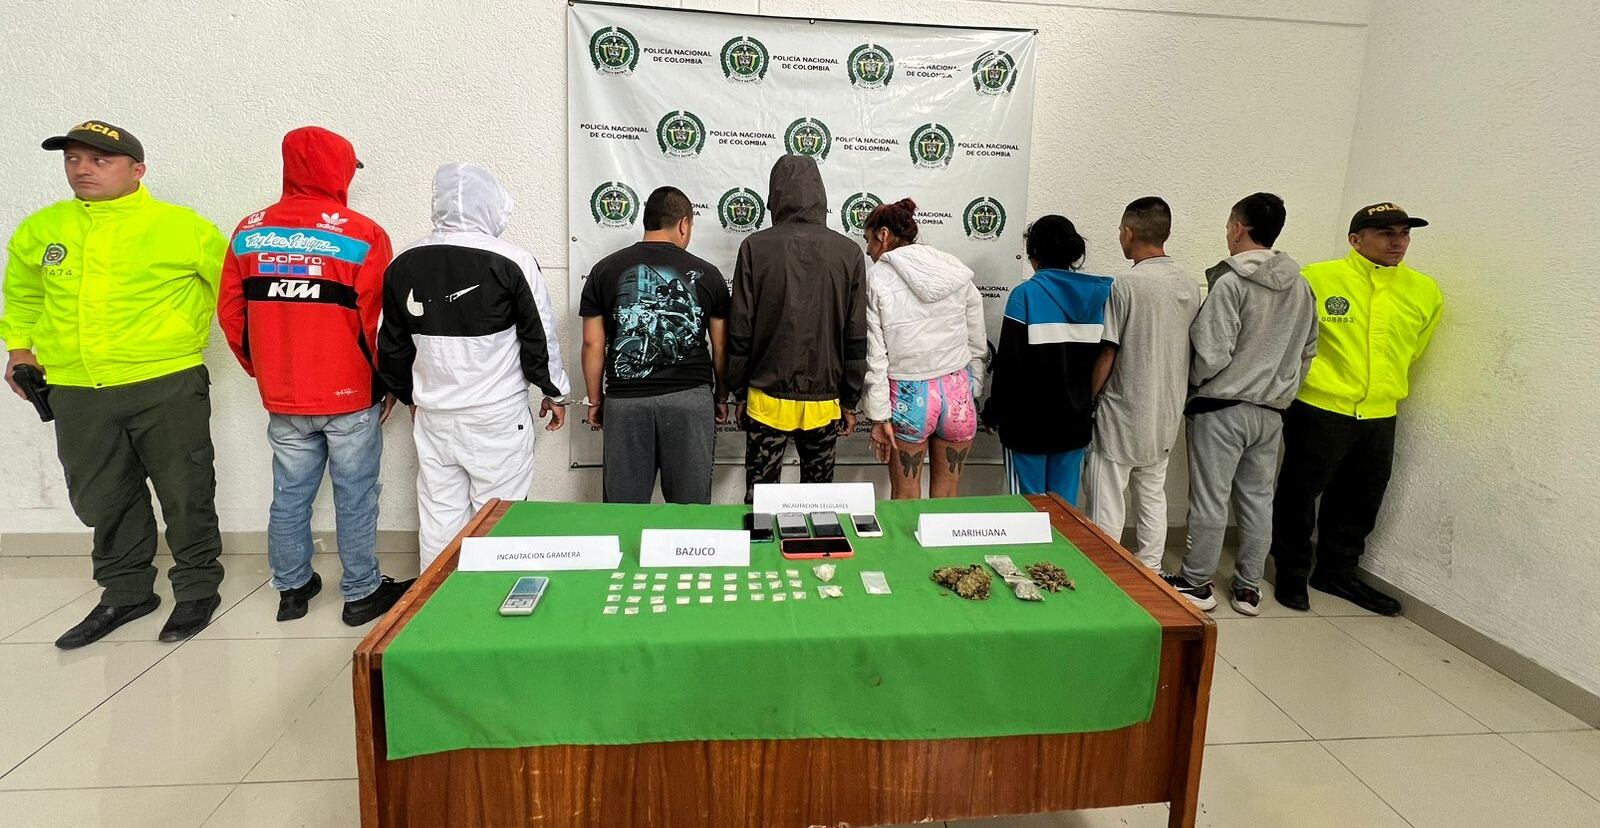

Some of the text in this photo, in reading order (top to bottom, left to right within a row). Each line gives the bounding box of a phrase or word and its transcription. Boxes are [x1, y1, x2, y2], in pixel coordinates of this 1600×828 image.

[643, 47, 712, 57] POLICÍA NACIONAL
[802, 56, 839, 64] NACIONAL
[611, 125, 649, 133] NACIONAL
[601, 132, 640, 140] COLOMBIA
[739, 131, 776, 139] NACIONAL
[986, 143, 1020, 151] NACIONAL
[316, 222, 344, 233] adidas
[267, 279, 321, 299] KTM
[951, 527, 1007, 538] MARIHUANA
[496, 551, 581, 561] INCAUTACION GRAMERA
[675, 547, 715, 557] BAZUCO
